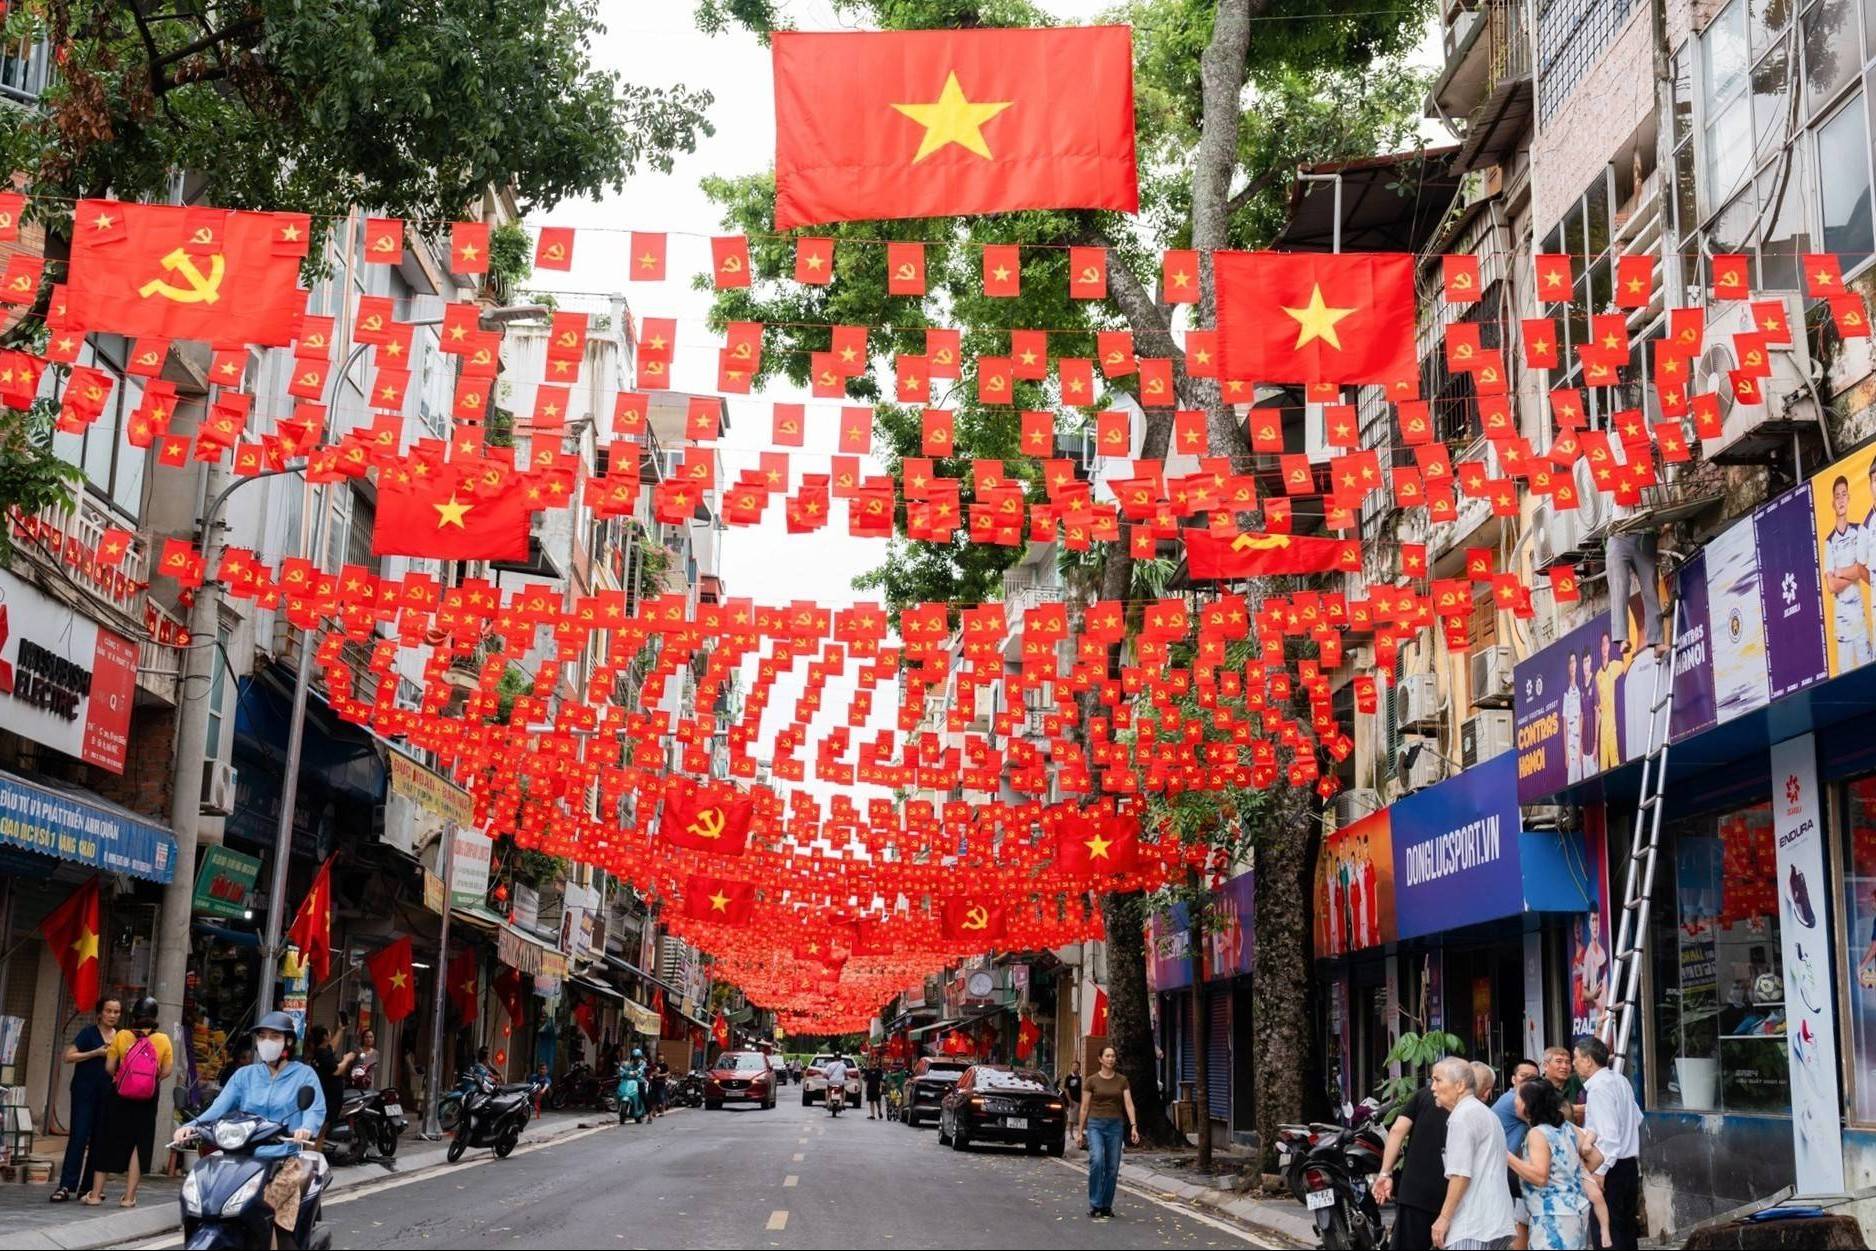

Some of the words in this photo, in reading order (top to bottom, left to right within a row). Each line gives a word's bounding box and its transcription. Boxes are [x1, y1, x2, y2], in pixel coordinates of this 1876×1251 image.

[1675, 640, 1706, 677] HANOI
[1518, 711, 1559, 751] CONTRAS
[1518, 746, 1546, 779] HANOI
[1405, 813, 1500, 887] DONGLUCSPORT.VN
[1779, 818, 1814, 849] ENDURA
